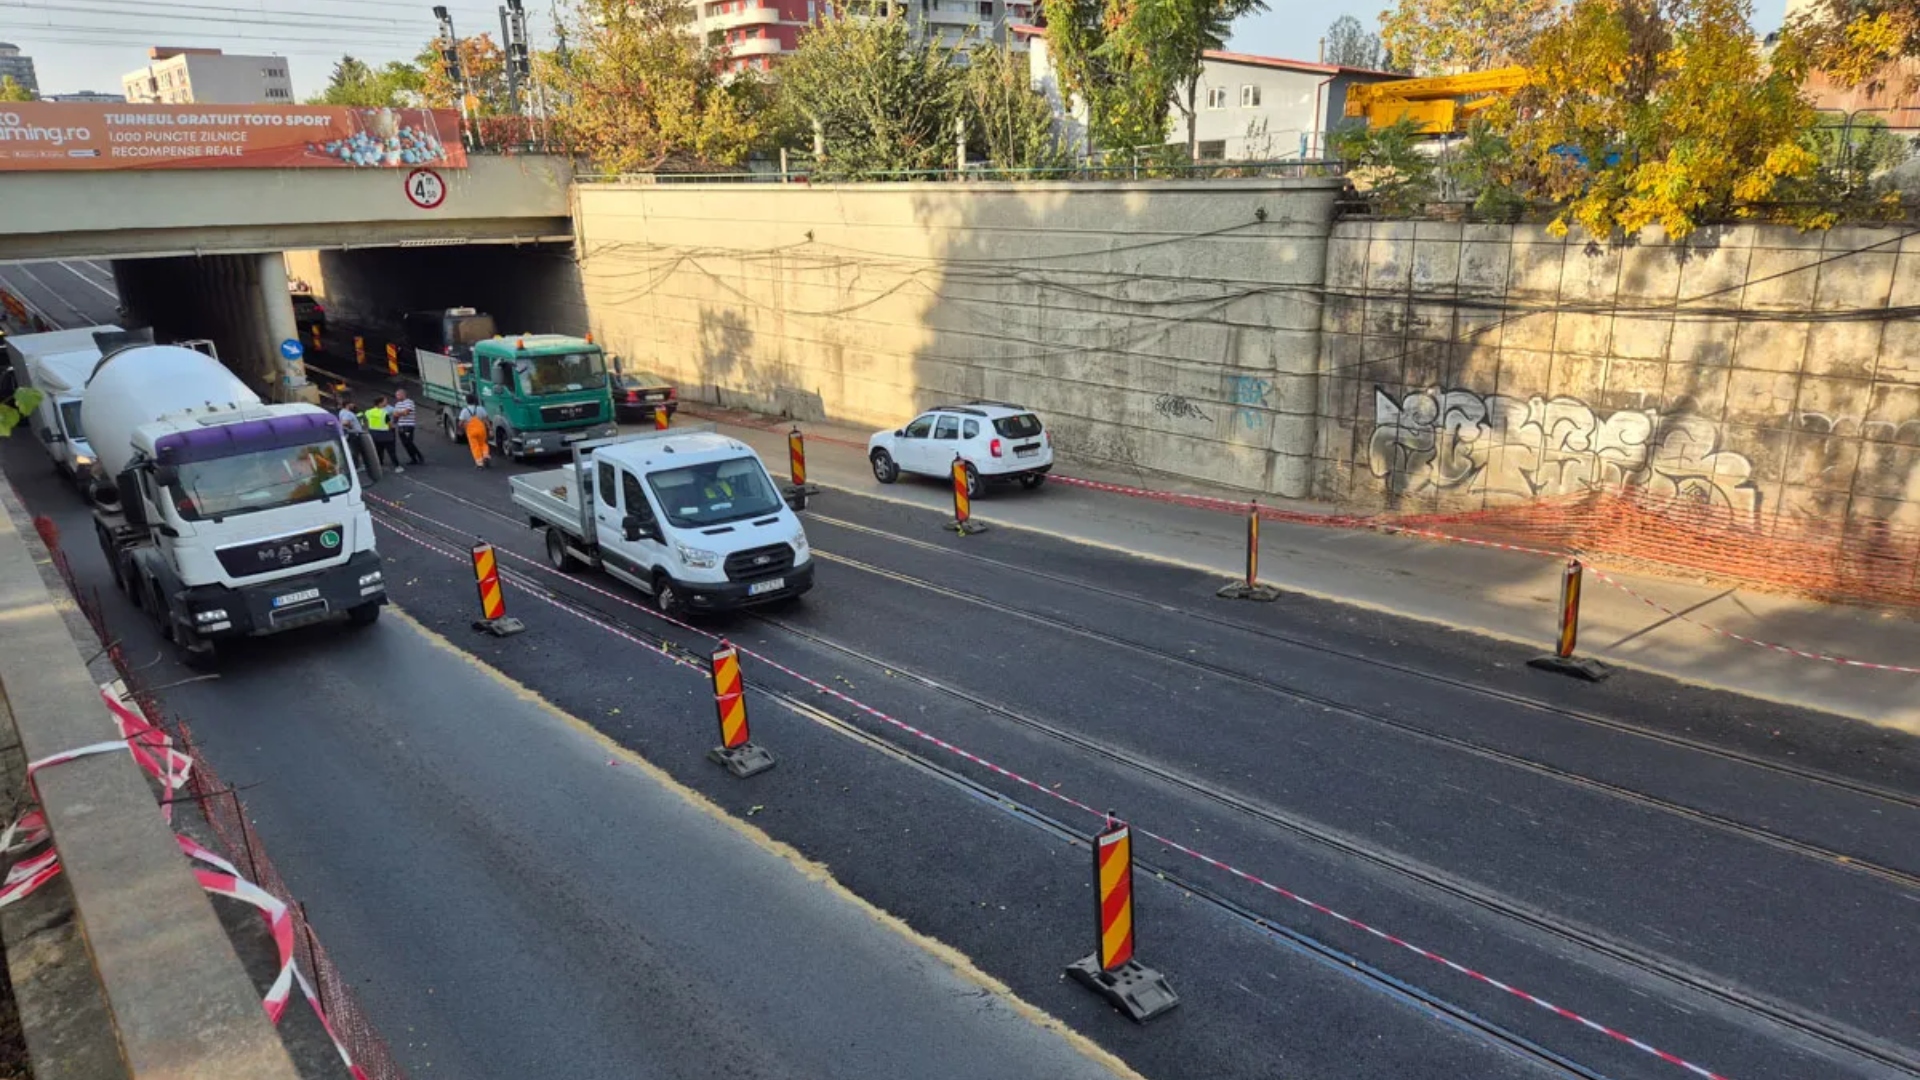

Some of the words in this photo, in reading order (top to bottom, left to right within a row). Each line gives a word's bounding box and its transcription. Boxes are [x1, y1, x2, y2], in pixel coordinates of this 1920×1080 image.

[104, 113, 174, 125] TURNEUL
[177, 113, 241, 126] GRATUIT
[243, 114, 283, 126] TOTO
[285, 115, 332, 127] SPORT
[109, 131, 142, 142] 1.000
[145, 131, 197, 142] PUNCTE
[200, 131, 248, 142] ZILNICE
[111, 146, 202, 157] RECOMPENSE
[205, 145, 244, 156] REALE
[415, 179, 426, 198] 4
[257, 540, 310, 560] MAN
